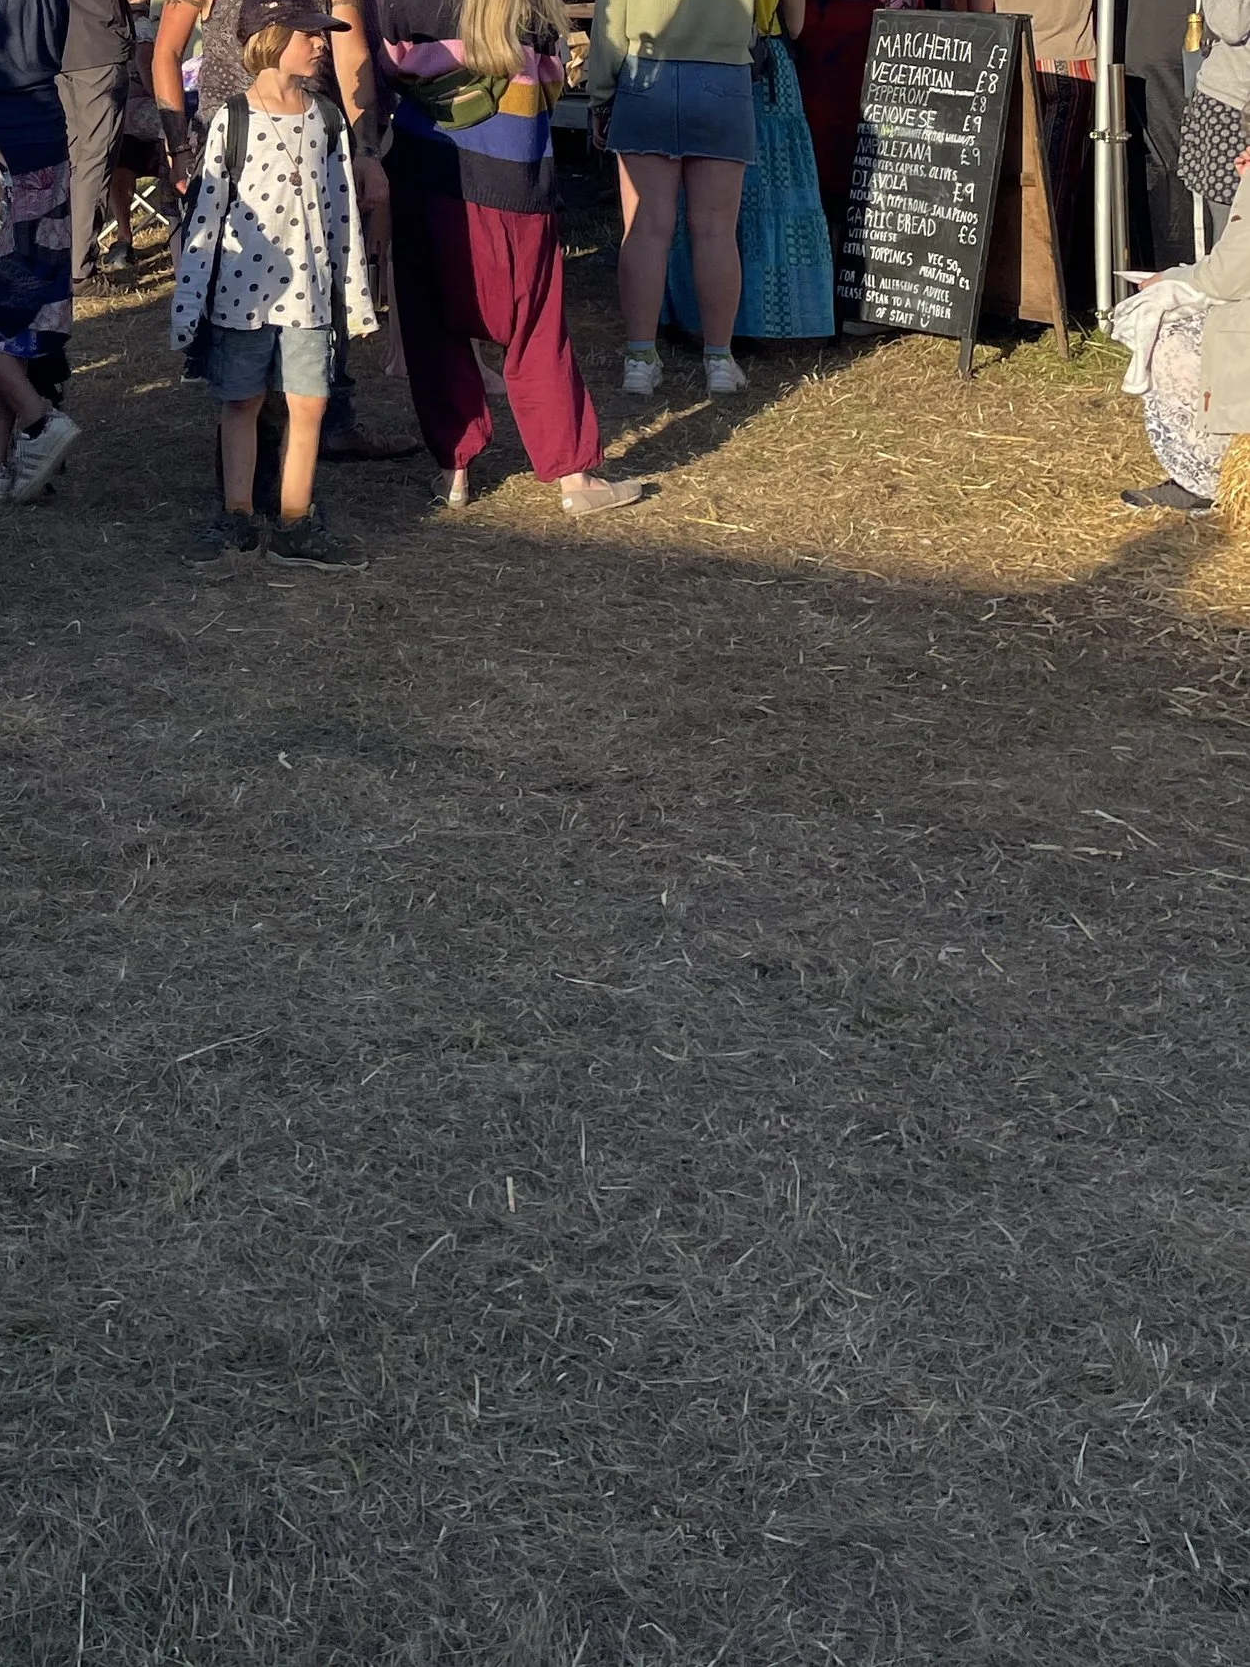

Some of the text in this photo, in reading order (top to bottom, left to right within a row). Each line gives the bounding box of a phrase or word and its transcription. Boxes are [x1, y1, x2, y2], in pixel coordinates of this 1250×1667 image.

[875, 32, 1009, 70] MARGHERITA £7
[870, 59, 1000, 95] VEGETARIAN £8
[867, 82, 931, 107] PEPPERONI
[970, 94, 987, 113] £8
[863, 103, 983, 134] GENOVESE £9
[856, 135, 982, 167] NAPOLETANA £9
[852, 169, 976, 204] DIAVOLA £9
[929, 165, 958, 182] OLIVES
[846, 206, 978, 246] GARLIC BREAD £6
[843, 242, 914, 267] EXTRA TOPPINGS
[927, 252, 945, 268] VEG
[839, 268, 856, 283] FOR
[859, 272, 877, 289] ALL
[836, 285, 952, 320] PLEASE SPEAK TO A MEMBER
[875, 307, 915, 326] OF STAFF
